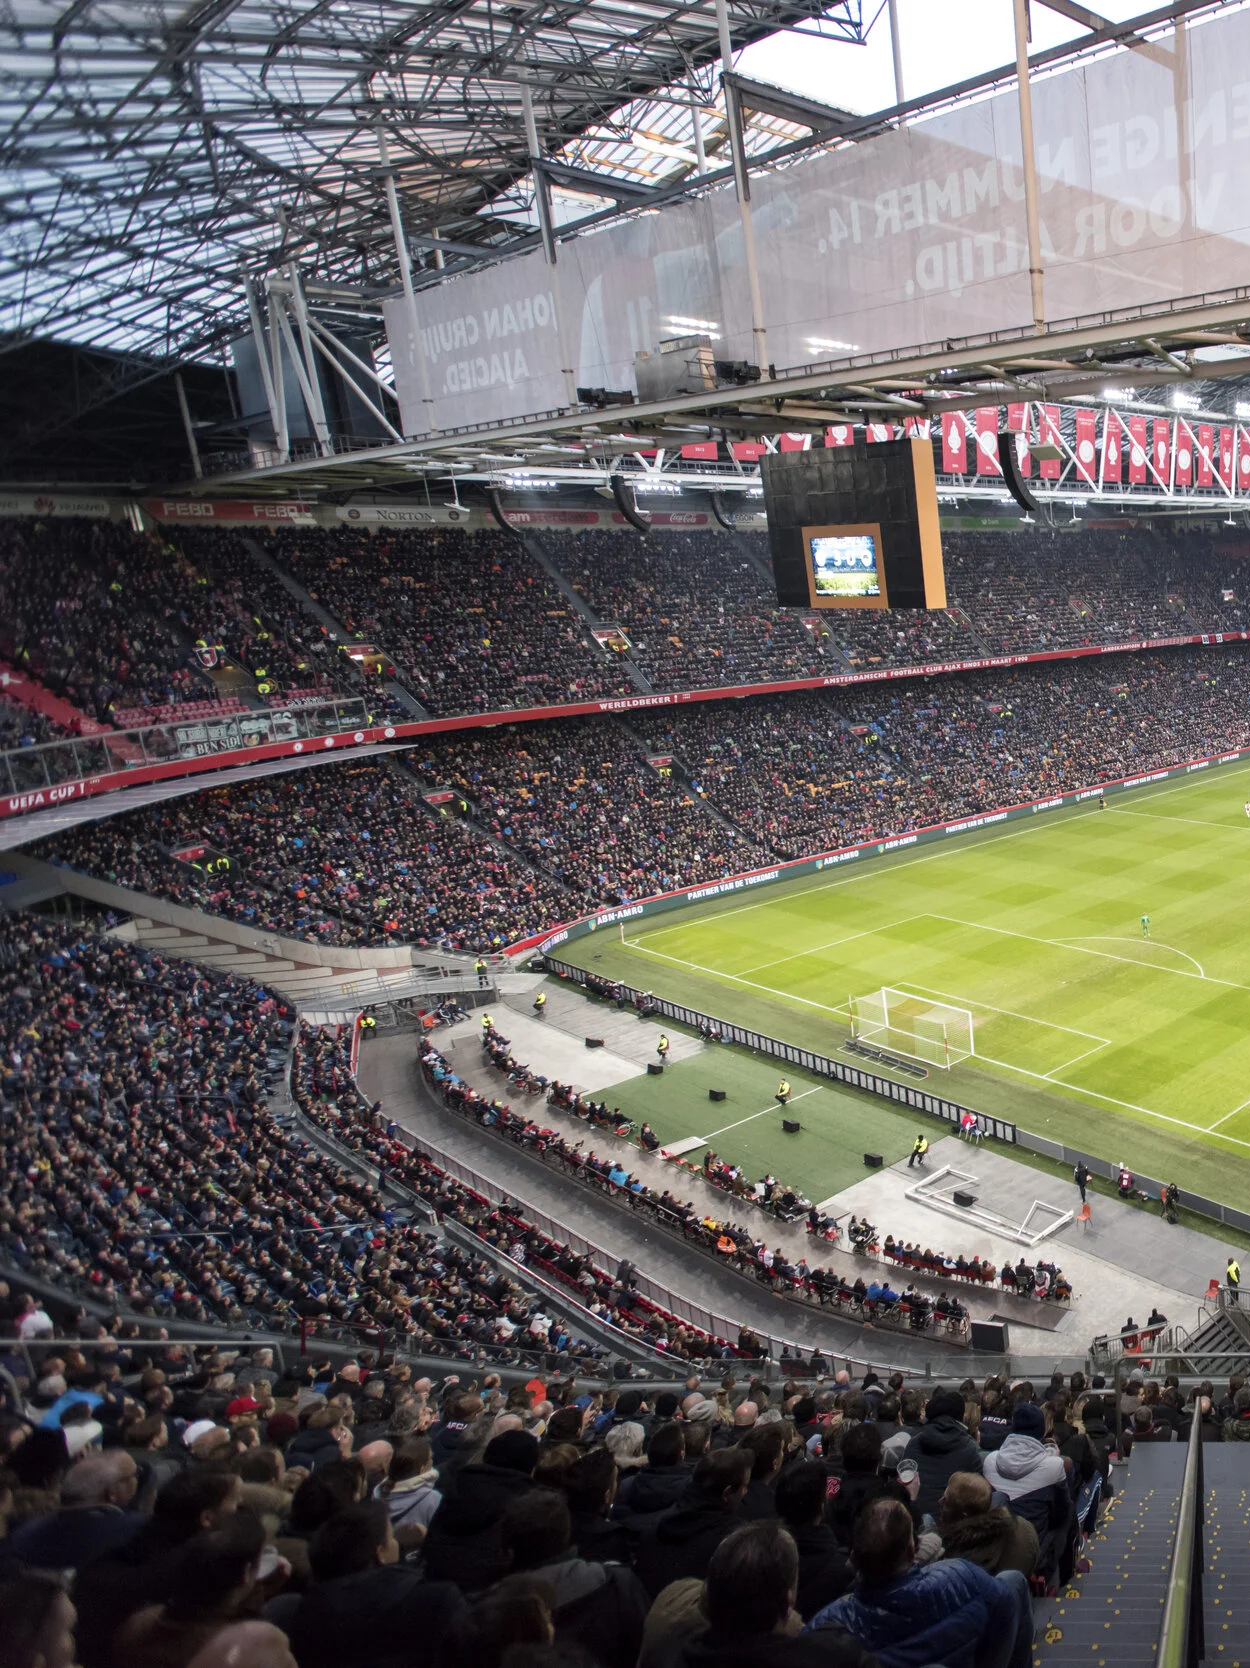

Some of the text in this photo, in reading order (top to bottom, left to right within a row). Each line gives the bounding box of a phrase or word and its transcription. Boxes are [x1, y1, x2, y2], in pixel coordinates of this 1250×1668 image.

[163, 502, 214, 516] FEBO
[890, 667, 924, 677] FOOTBALL
[926, 665, 943, 673] CLUB
[944, 663, 961, 671] AJAX
[962, 661, 980, 669] SINDS
[599, 695, 671, 710] WERELDBEKER
[197, 741, 219, 755] BEN
[9, 786, 75, 811] UEFA CUP
[946, 822, 967, 833] PARTNER
[967, 820, 976, 829] VAN
[687, 870, 779, 900] PARTNER VAN DE TOEKOMST
